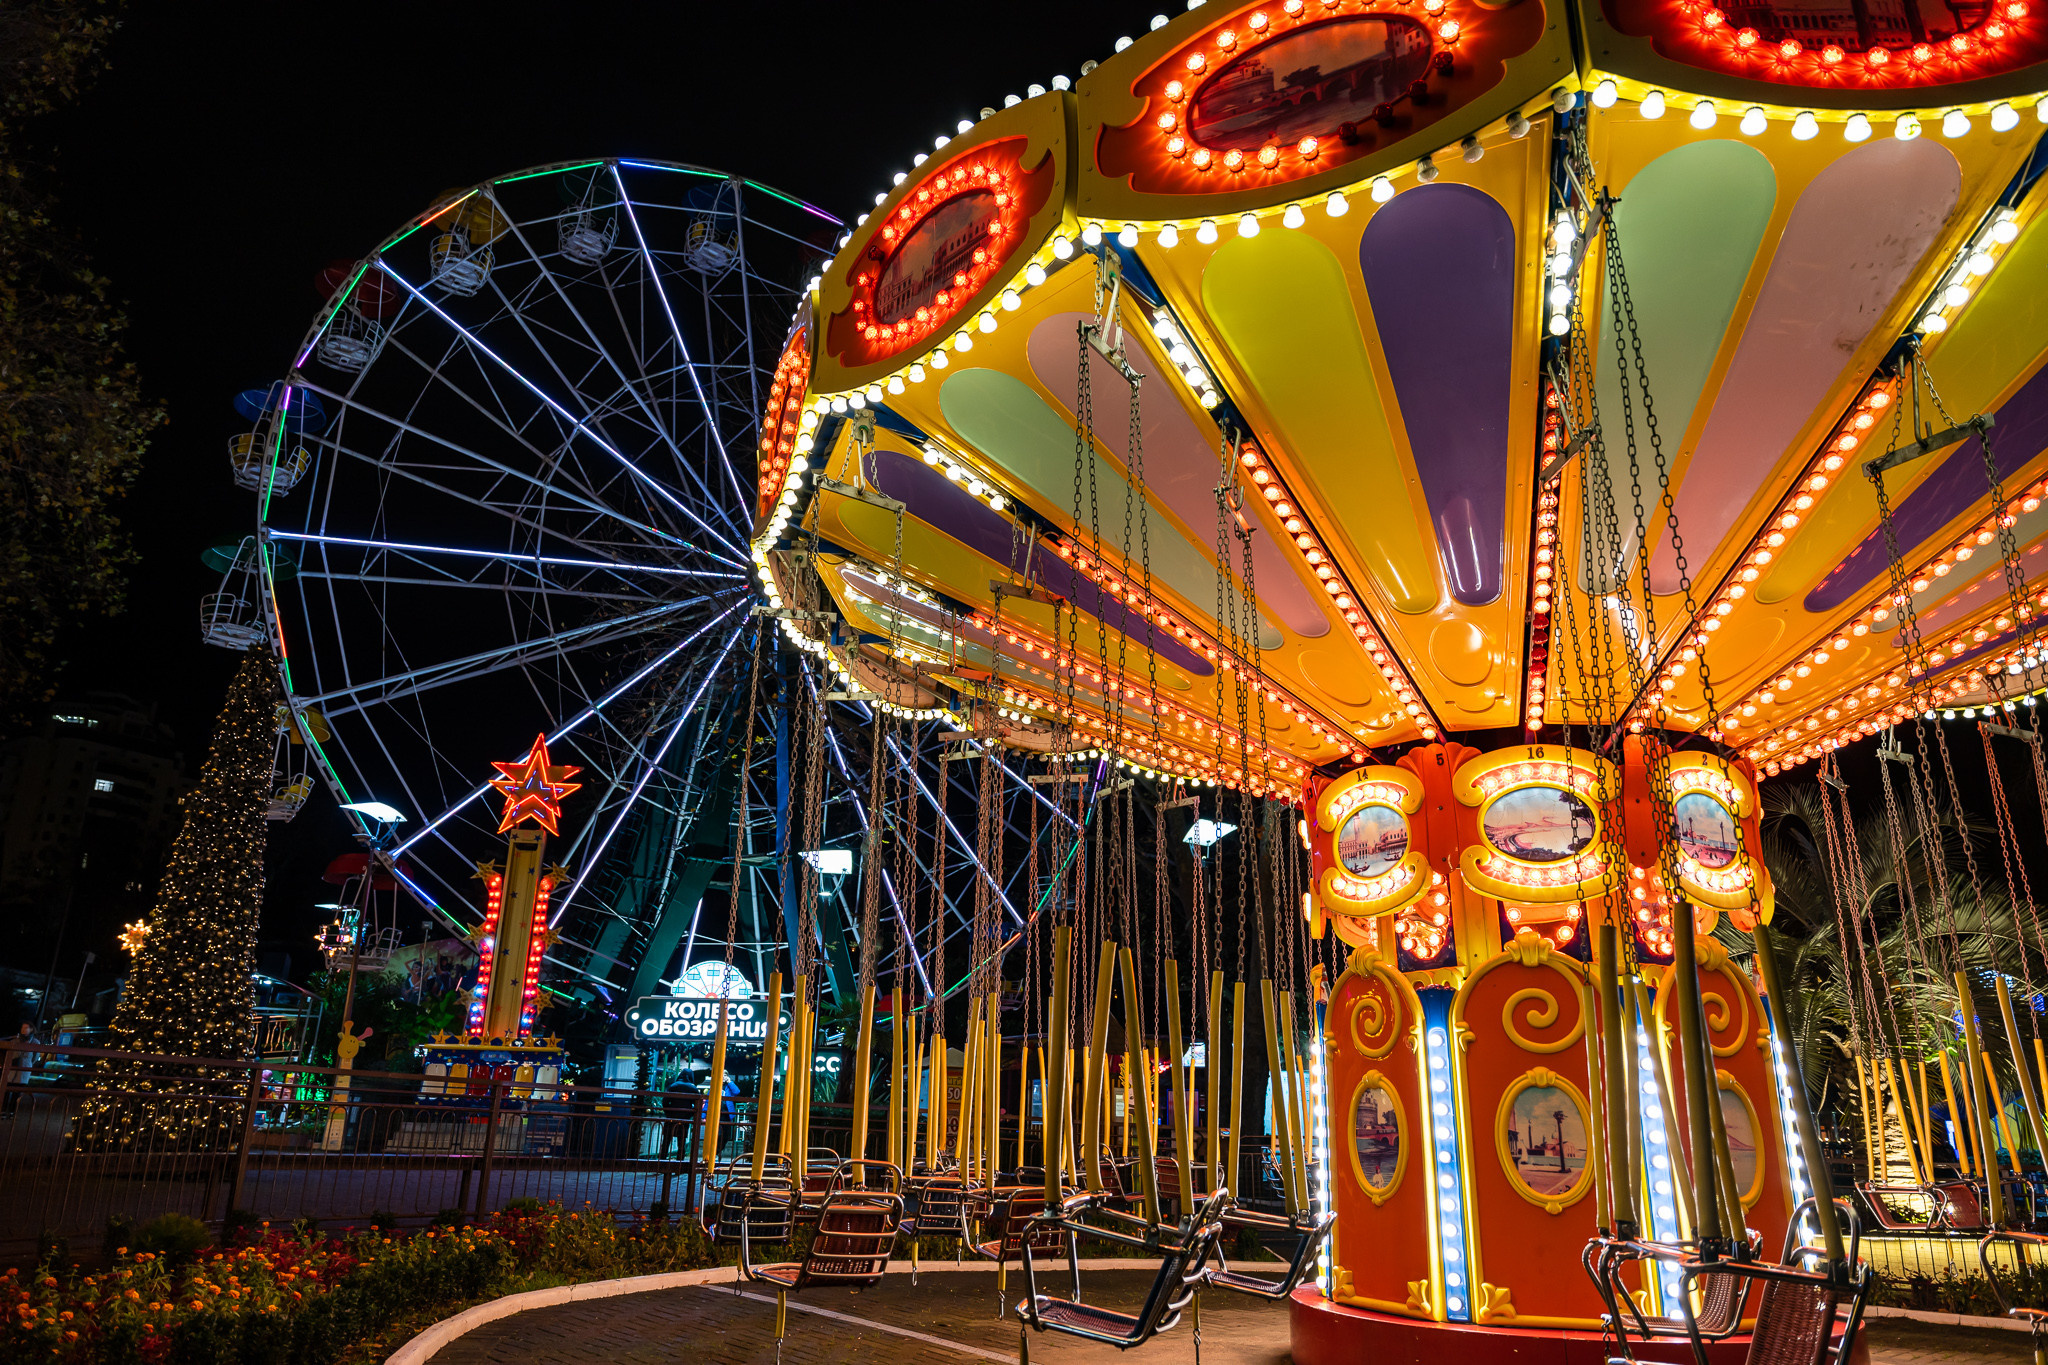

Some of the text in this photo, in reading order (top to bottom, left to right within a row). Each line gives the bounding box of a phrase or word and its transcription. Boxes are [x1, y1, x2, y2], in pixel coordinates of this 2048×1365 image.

[1435, 753, 1444, 766] 5
[1527, 747, 1545, 760] 16
[1702, 754, 1708, 766] 2
[1356, 768, 1369, 782] 14
[664, 1002, 754, 1020] КОЛЕСО
[641, 1018, 768, 1038] ОБОЗРНИЯ
